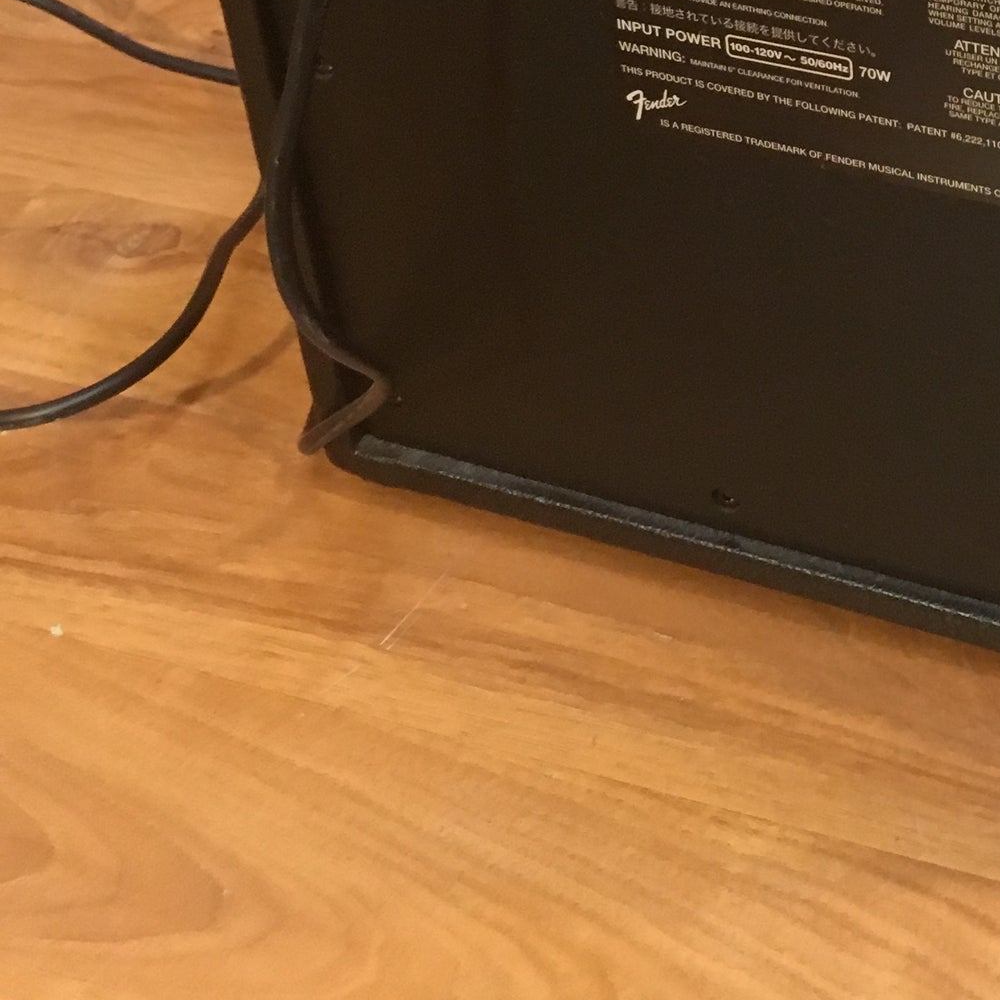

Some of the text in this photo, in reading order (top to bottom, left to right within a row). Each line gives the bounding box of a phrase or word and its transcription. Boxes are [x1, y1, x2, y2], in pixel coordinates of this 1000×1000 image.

[616, 17, 662, 37] INPUT
[665, 27, 721, 49] POWER
[799, 54, 849, 75] 50/60Hz
[859, 66, 891, 83] 70W
[618, 39, 685, 64] WARNING:
[620, 63, 643, 76] THIS
[645, 68, 692, 86] PRODUCT
[694, 79, 704, 88] IS
[706, 81, 754, 99] COVERED
[757, 91, 771, 102] BY
[773, 95, 792, 107] THE
[795, 99, 855, 120] FOLLOWING
[906, 122, 947, 139] PATENT
[626, 89, 687, 120] Fender
[660, 117, 669, 127] IS
[671, 120, 679, 129] A
[681, 122, 742, 143] REGISTERED
[744, 135, 805, 156] TRADEMARK
[808, 149, 821, 159] OF
[825, 152, 865, 169] FENDER
[868, 161, 914, 179] MUSICAL
[916, 171, 991, 196] INSTRUMENTS
